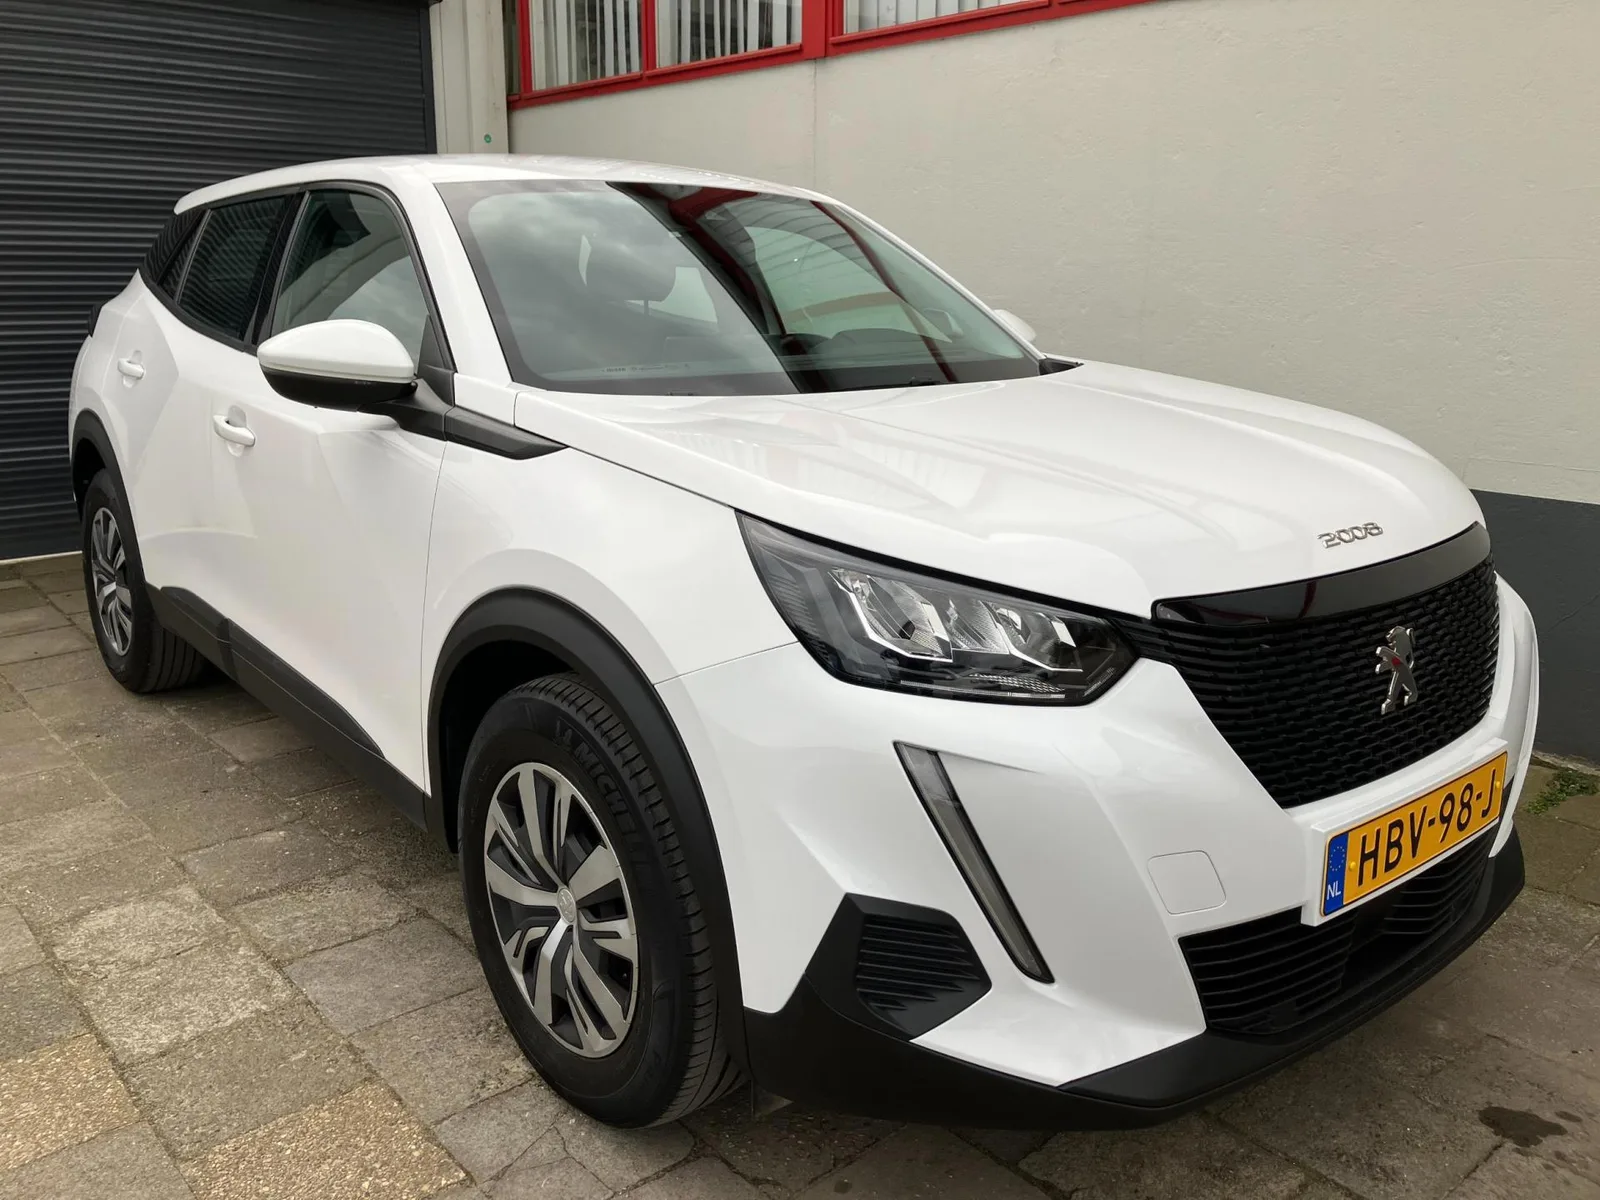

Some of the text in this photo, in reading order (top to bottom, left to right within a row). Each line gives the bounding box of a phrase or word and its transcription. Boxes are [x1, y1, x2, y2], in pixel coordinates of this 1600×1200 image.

[1317, 522, 1383, 548] 2008
[573, 741, 655, 893] MICHEL
[1358, 768, 1496, 887] HBV-98-J
[1327, 880, 1341, 900] NL
